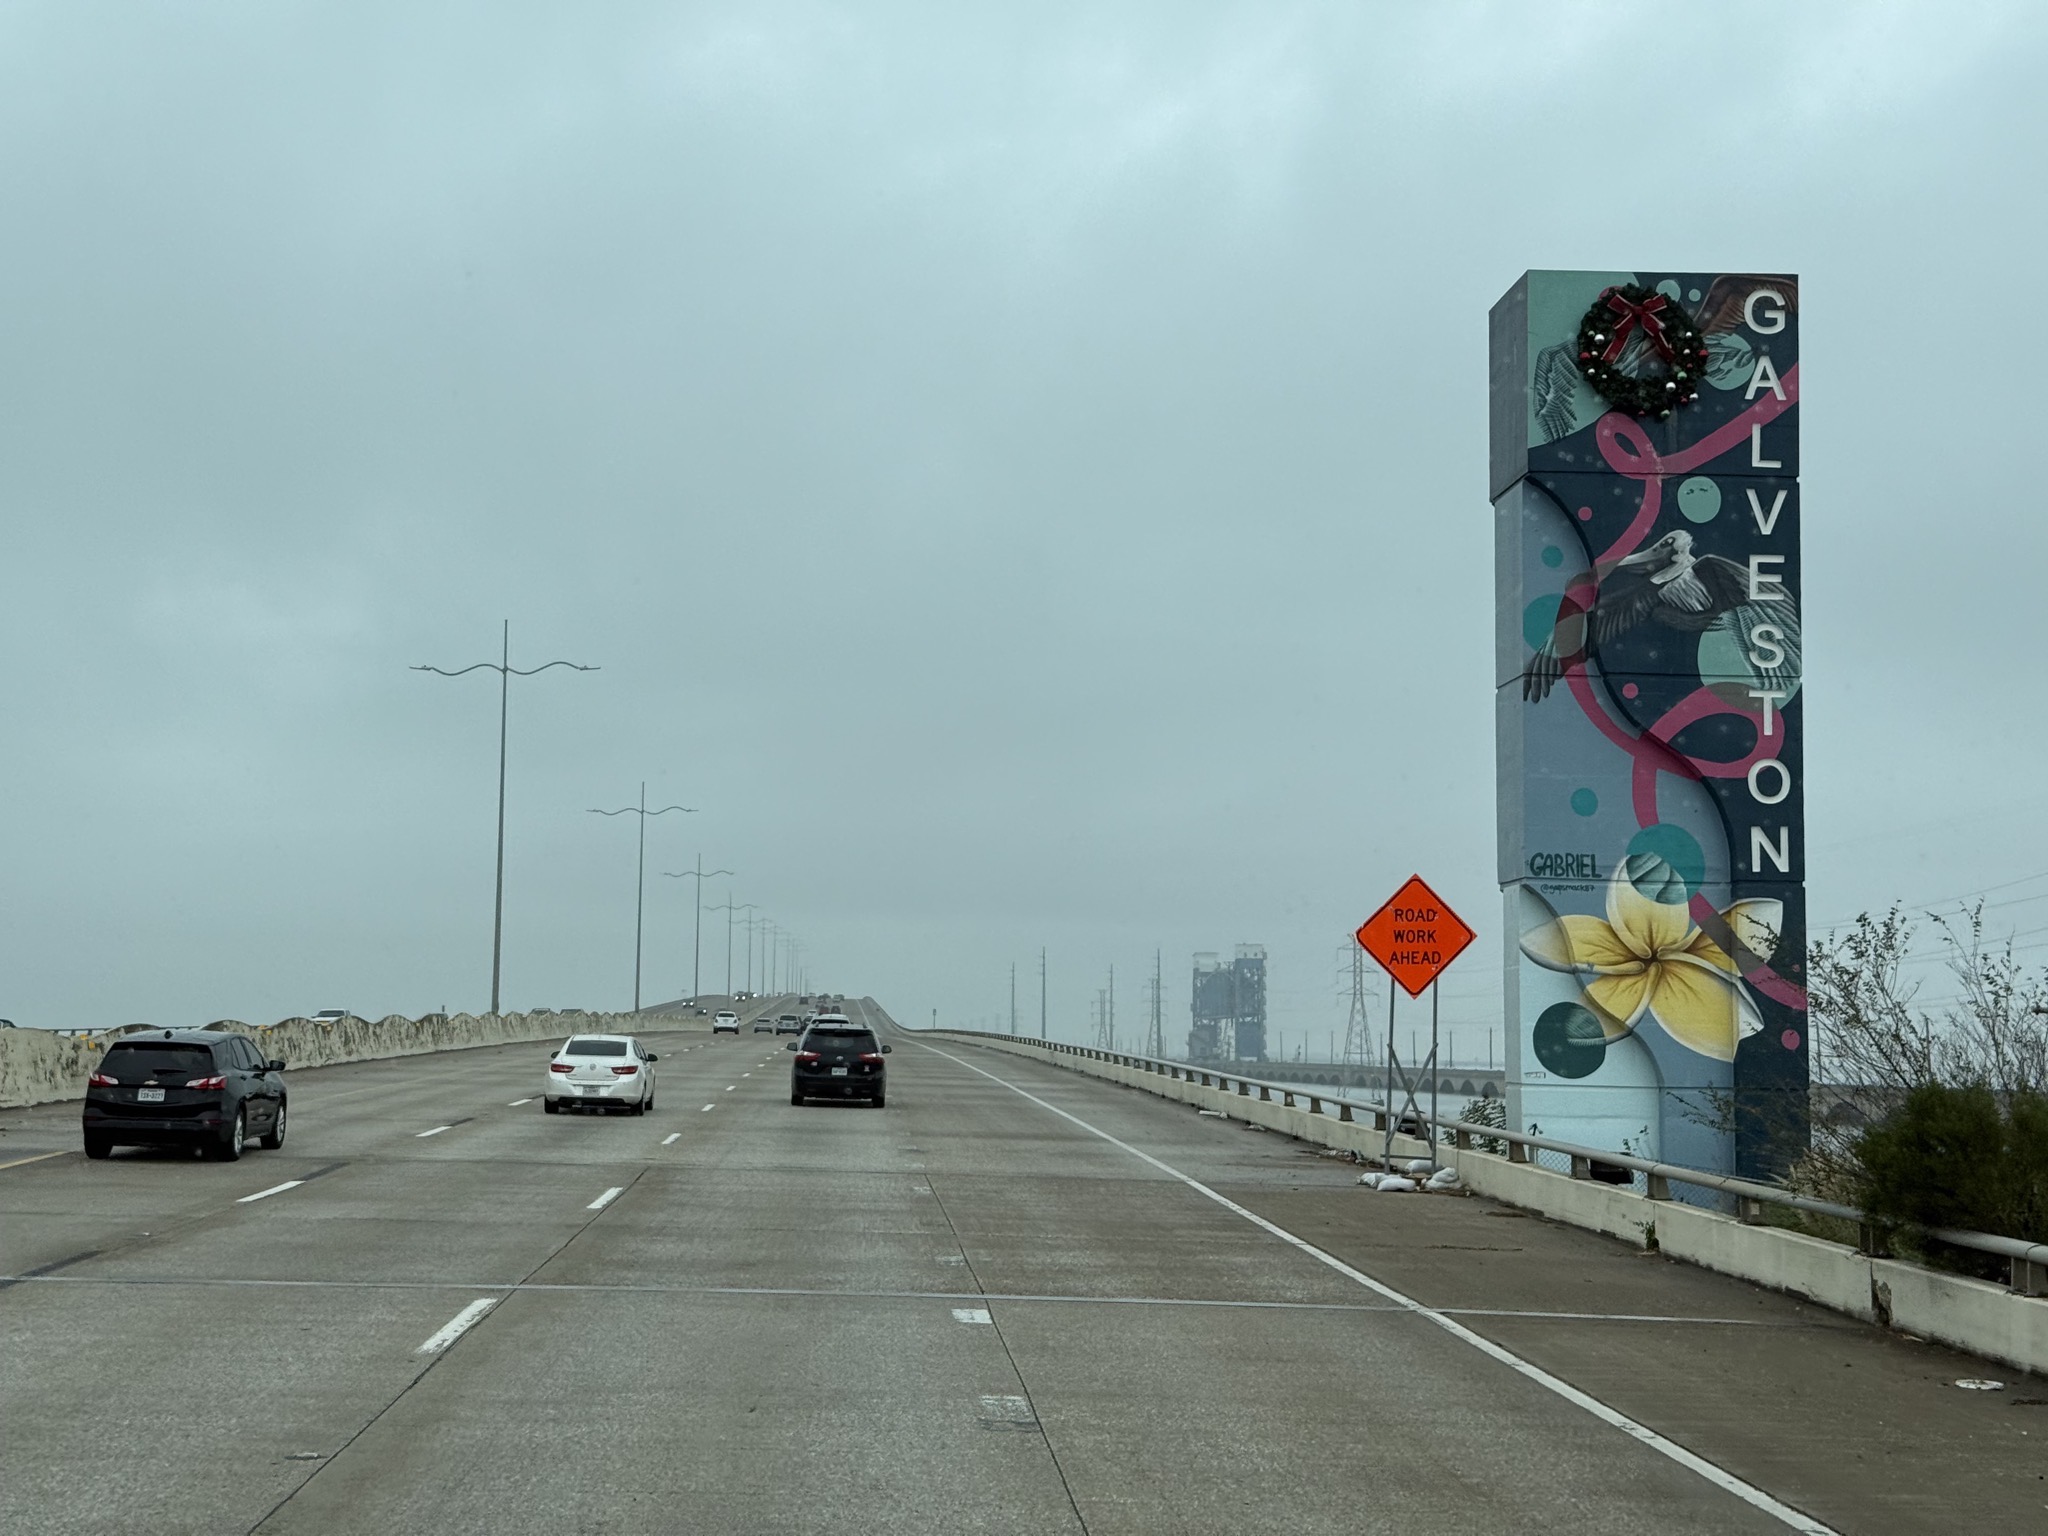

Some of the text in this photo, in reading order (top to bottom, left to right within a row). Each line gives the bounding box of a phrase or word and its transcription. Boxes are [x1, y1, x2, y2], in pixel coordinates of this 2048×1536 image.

[1743, 289, 1792, 873] GALVESTON
[1529, 852, 1602, 878] GABRIEL
[1394, 908, 1437, 922] ROAD
[1393, 930, 1437, 943] WORK
[1388, 951, 1441, 965] AHEAD
